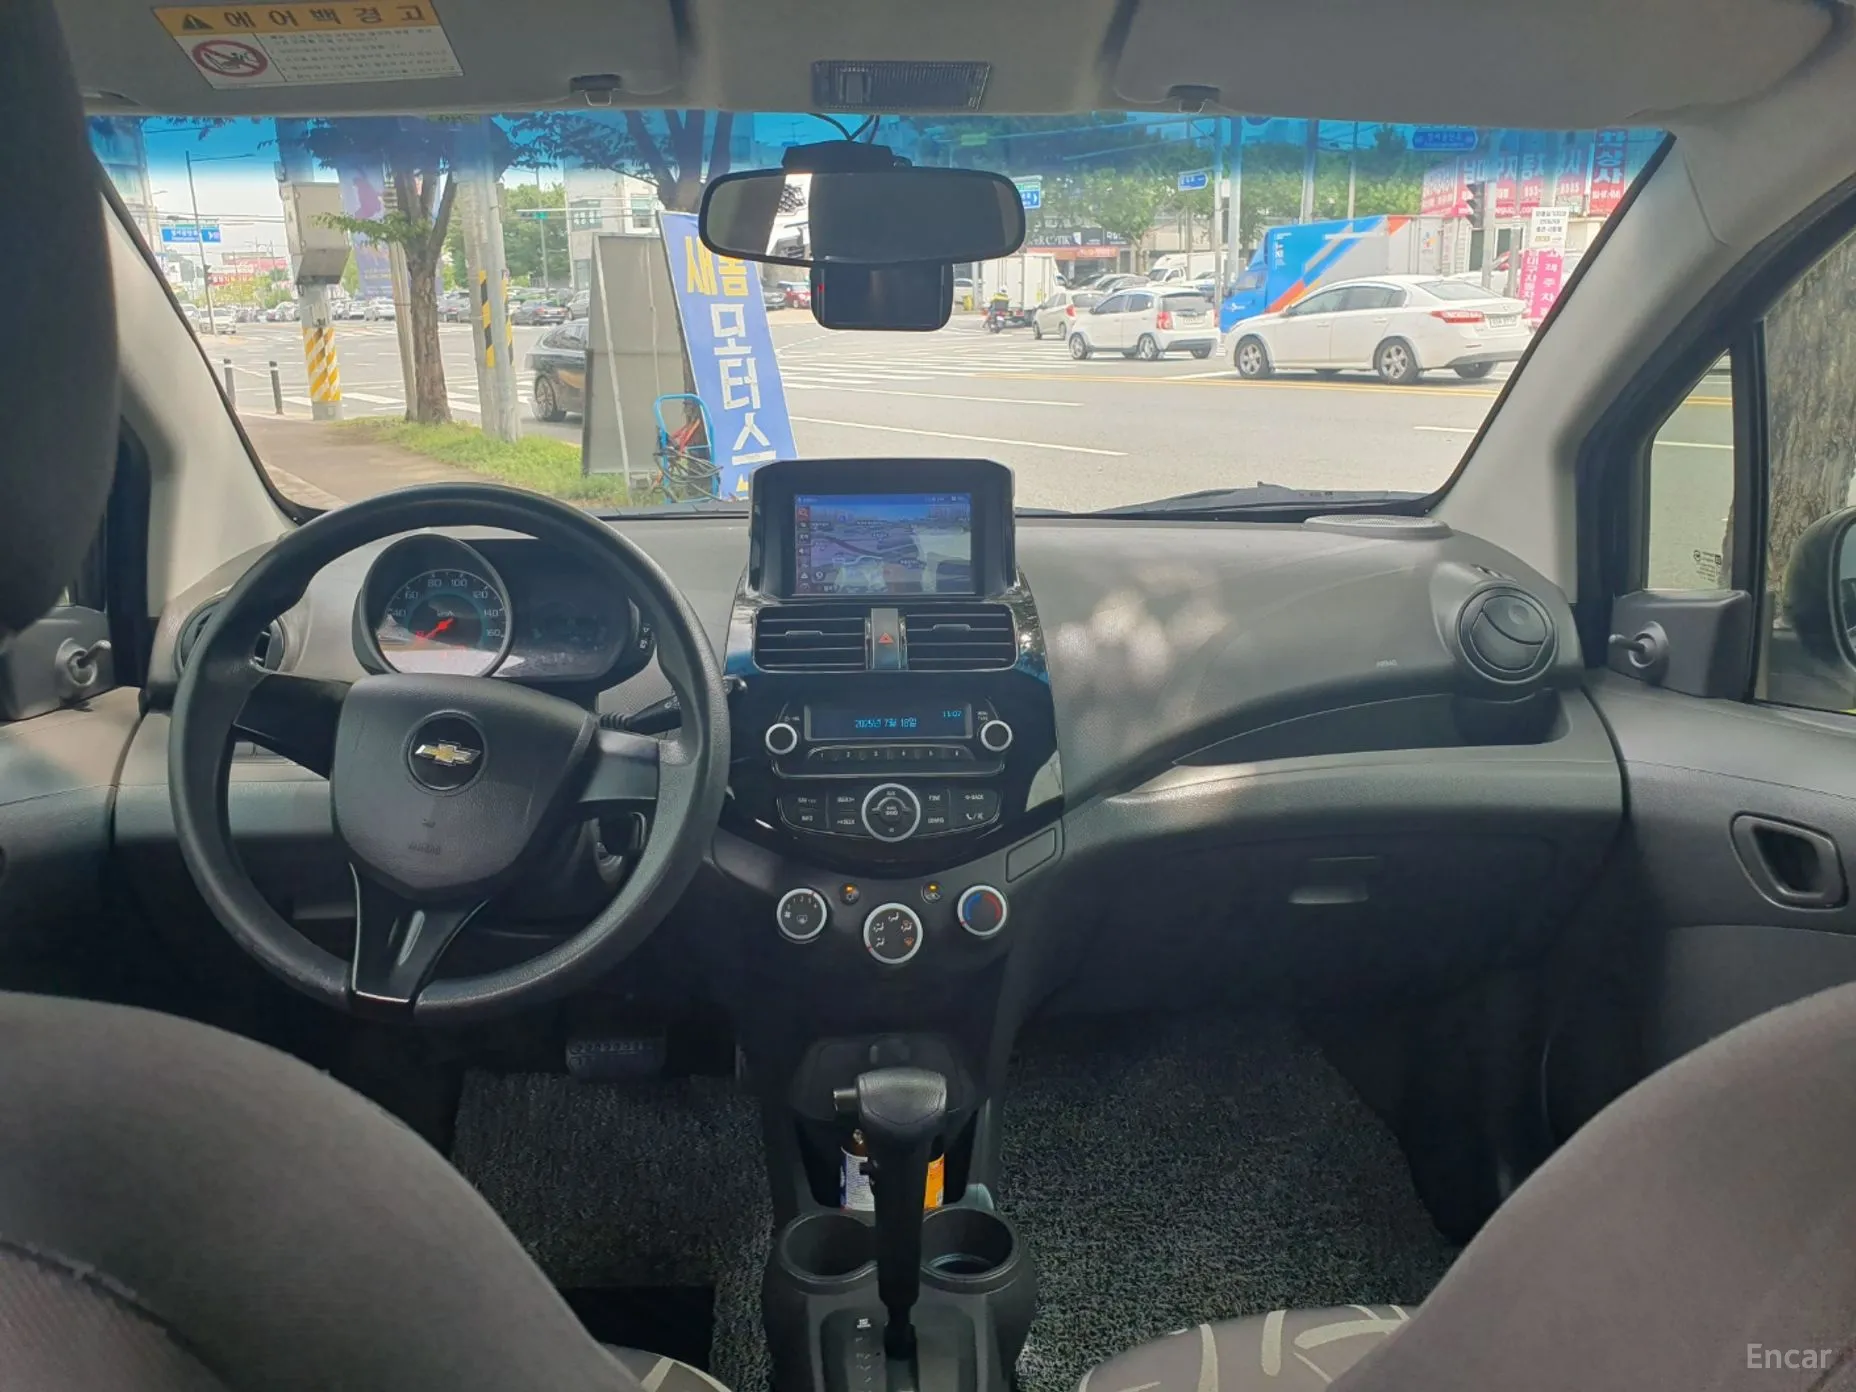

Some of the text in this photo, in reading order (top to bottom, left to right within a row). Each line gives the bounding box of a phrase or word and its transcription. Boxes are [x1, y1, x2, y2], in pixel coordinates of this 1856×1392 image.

[710, 303, 777, 466] 모터스
[427, 579, 442, 587] 80
[451, 579, 468, 587] 100
[405, 591, 418, 599] 60
[484, 609, 499, 617] 140
[487, 629, 501, 637] 160
